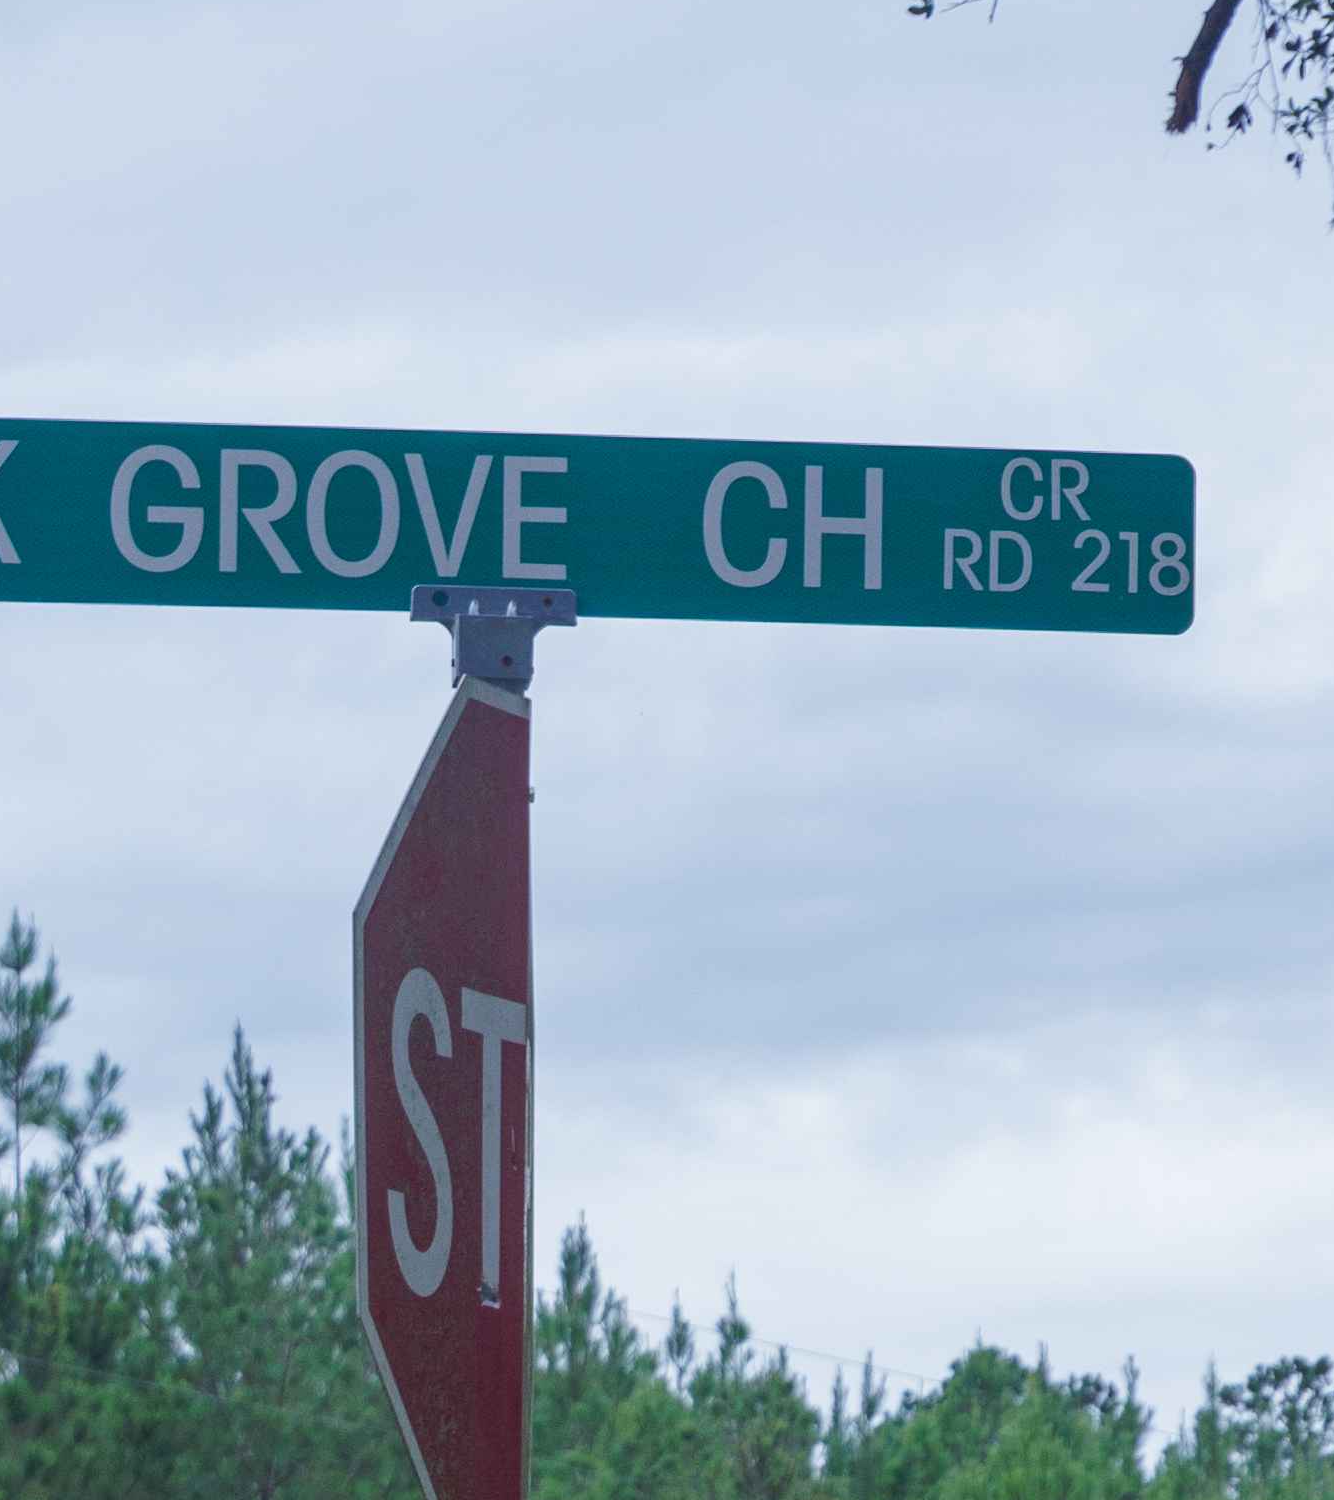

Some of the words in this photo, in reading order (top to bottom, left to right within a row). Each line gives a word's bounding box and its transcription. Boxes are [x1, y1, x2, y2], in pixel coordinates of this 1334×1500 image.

[109, 444, 569, 580] GROVE
[702, 460, 884, 590] CH
[1000, 457, 1091, 521] CR
[942, 528, 1034, 592] RD
[1070, 529, 1191, 596] 218
[386, 966, 527, 1309] ST
